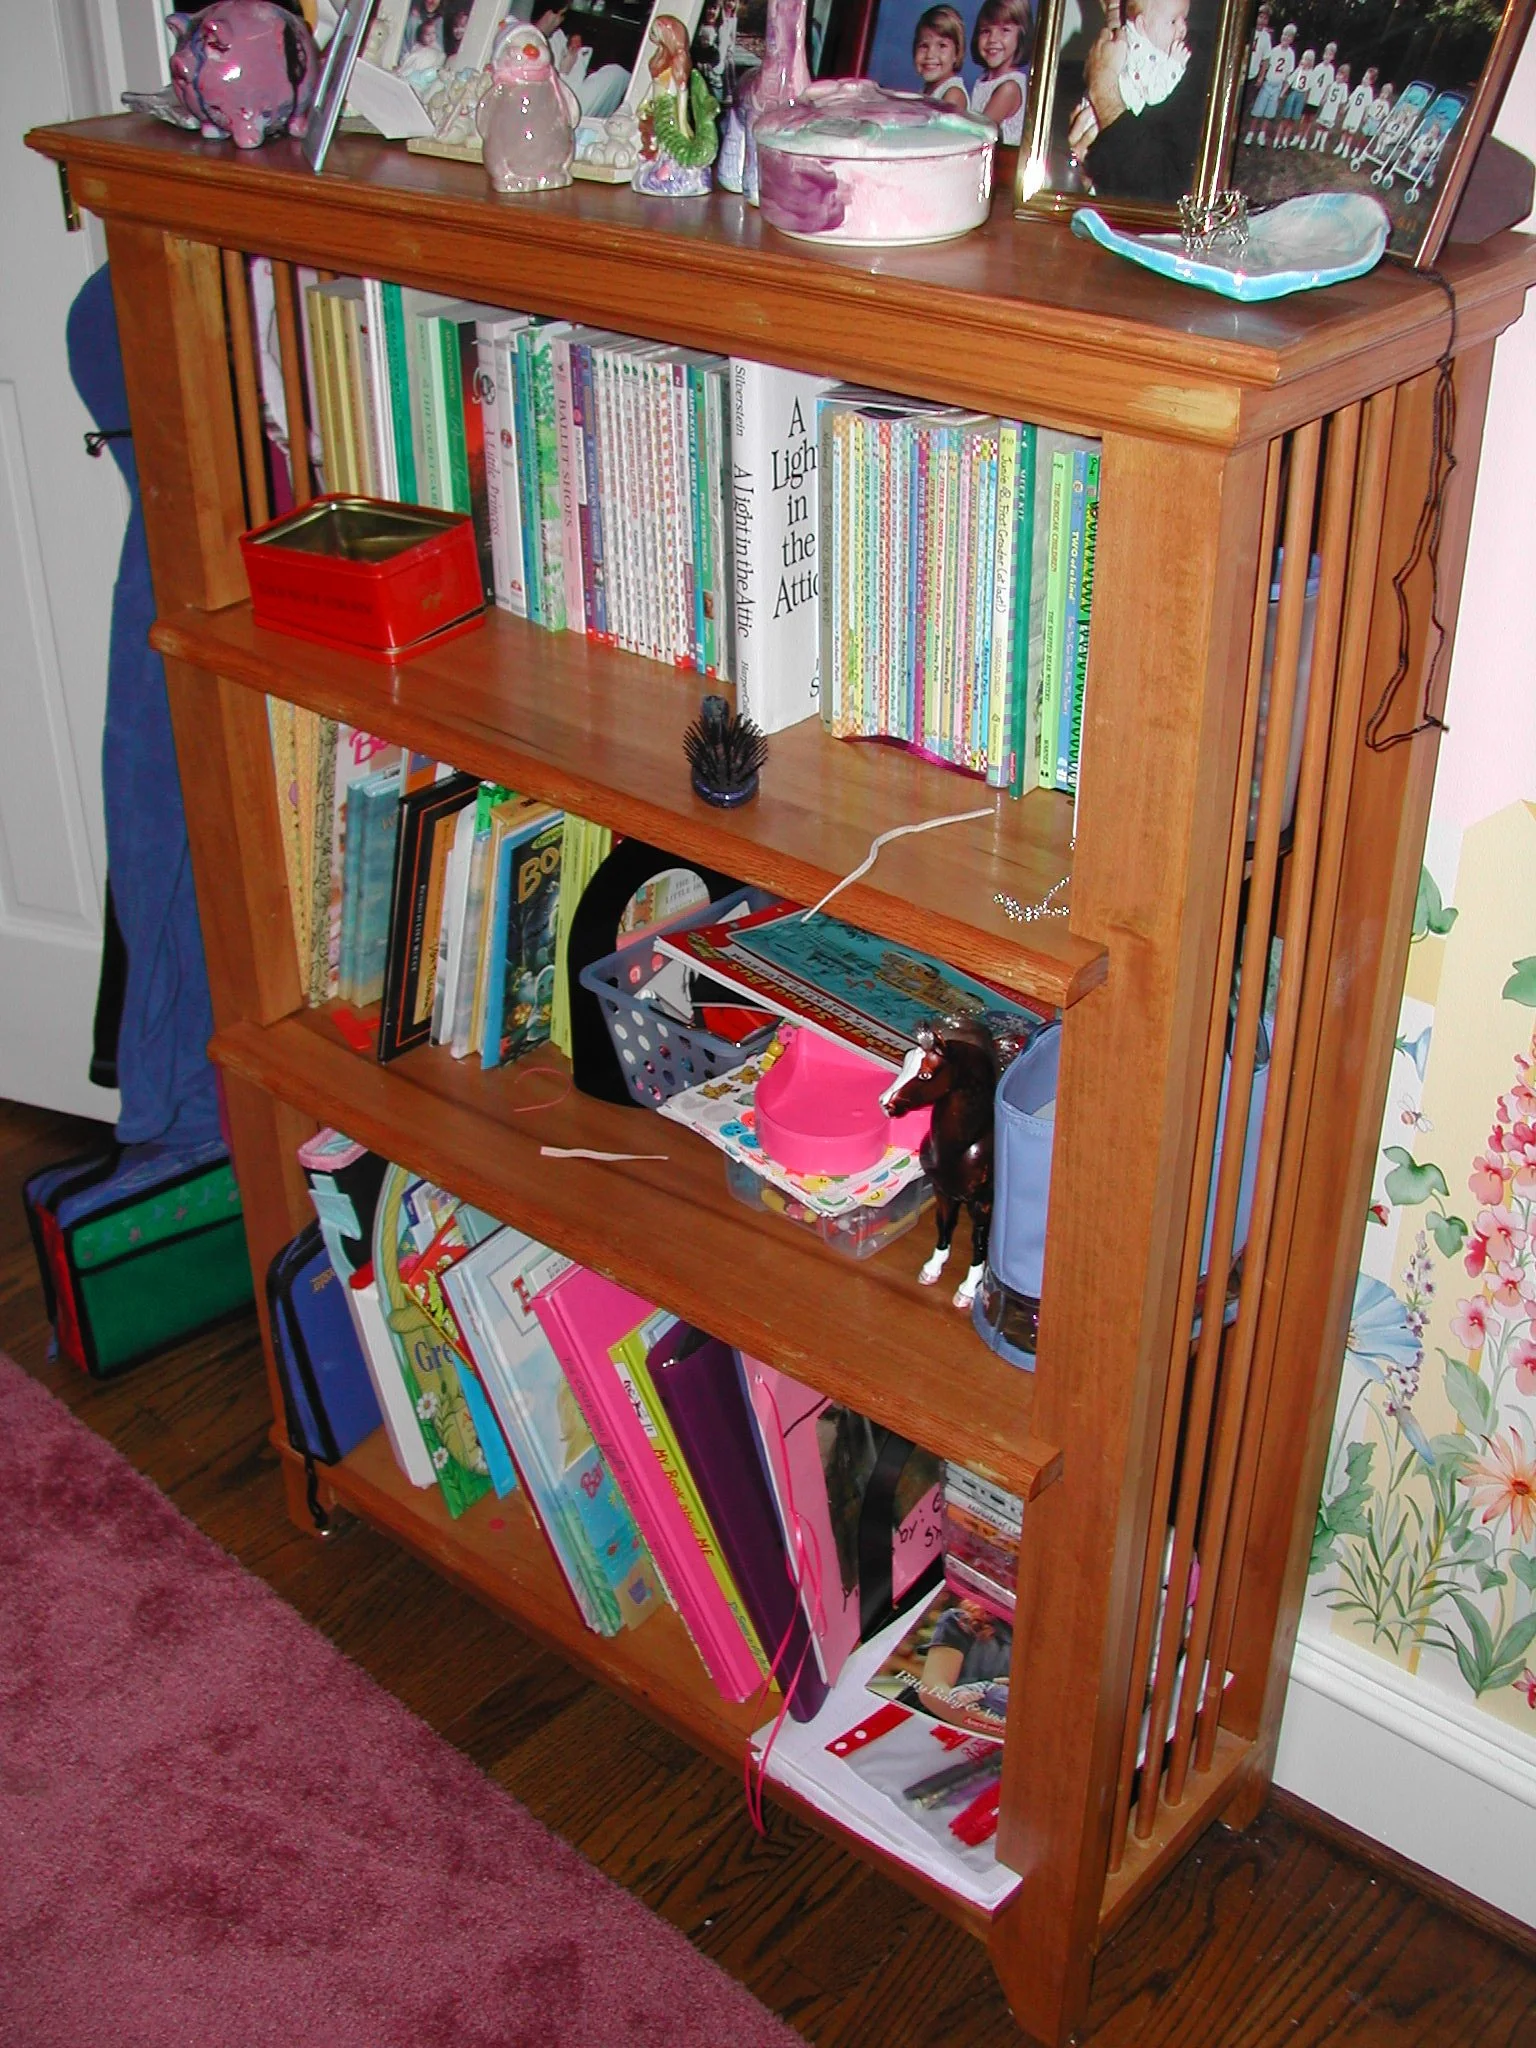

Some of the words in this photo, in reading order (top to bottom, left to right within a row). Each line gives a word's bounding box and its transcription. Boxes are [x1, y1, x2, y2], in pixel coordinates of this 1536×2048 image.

[1276, 58, 1285, 72] 2
[1299, 75, 1306, 88] 3
[1317, 73, 1325, 88] 4
[1331, 88, 1338, 102] 5
[1355, 93, 1364, 106] 6
[736, 365, 746, 436] Silverstein
[788, 396, 806, 438] A
[558, 399, 569, 466] BALLET
[626, 417, 634, 468] BABY-SITTERS
[486, 441, 498, 478] Little
[734, 464, 753, 478] A
[772, 437, 818, 490] Ligh
[999, 454, 1012, 484] Junie
[489, 484, 502, 536] Princess
[561, 468, 572, 527] SHOES
[734, 484, 754, 534] Light
[788, 494, 808, 526] in
[997, 504, 1010, 526] First
[736, 536, 751, 556] in
[782, 530, 815, 568] the
[996, 529, 1009, 566] Grader
[1050, 532, 1058, 572] CHILDREN
[1070, 530, 1079, 556] TWO
[736, 557, 754, 591] the
[995, 568, 1008, 584] (at
[1068, 576, 1076, 600] kind
[736, 591, 756, 638] Attic
[994, 585, 1007, 613] last!)
[518, 846, 562, 904] BO
[666, 888, 690, 904] LITTLE
[725, 959, 767, 987] Bus
[730, 950, 780, 982] MUSEUM
[766, 980, 831, 1023] School
[782, 979, 850, 1020] HAUNTED
[852, 1018, 880, 1036] THE
[886, 1036, 900, 1047] IN
[664, 1470, 684, 1499] Book
[680, 1502, 702, 1534] about
[696, 1538, 715, 1556] ME
[894, 1669, 928, 1694] Bitty
[928, 1686, 966, 1712] Baby
[966, 1702, 980, 1714] &
